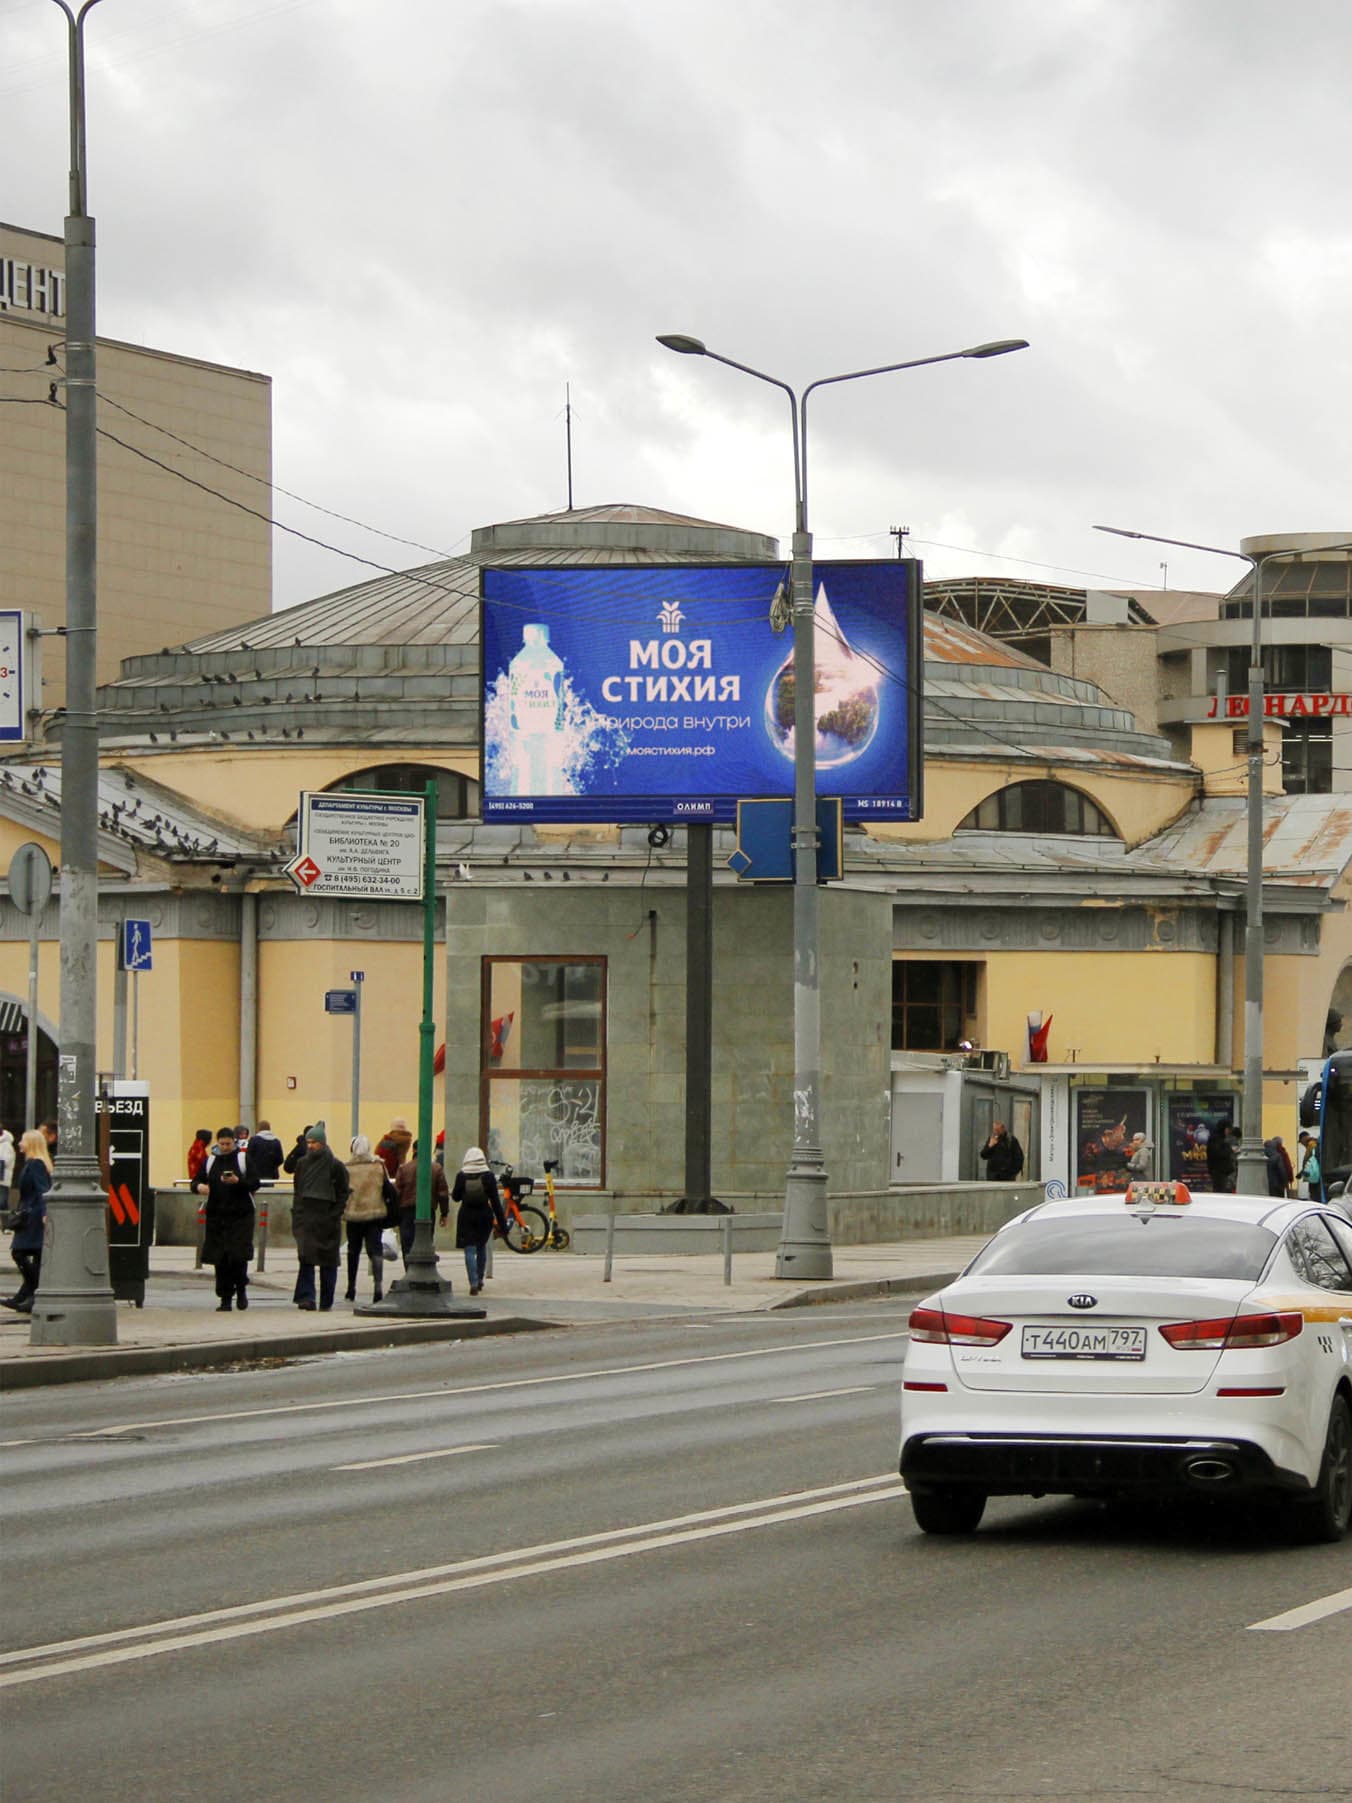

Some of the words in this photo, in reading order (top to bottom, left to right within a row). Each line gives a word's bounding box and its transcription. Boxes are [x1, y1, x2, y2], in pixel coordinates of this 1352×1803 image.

[629, 639, 712, 669] МОЯ
[0, 667, 8, 678] 3
[601, 675, 741, 702] СТИХИЯ
[683, 716, 751, 731] внутри
[627, 745, 716, 757] моястихия.рф
[330, 837, 378, 846] БИБЛИОТЕКА
[327, 856, 376, 864] КУЛЬТУРНЫЙ
[378, 858, 401, 866] ЦЕНТР
[341, 875, 360, 884] (495)
[314, 884, 368, 892] ГОСПИТАЛЬНЫЙ
[1072, 1296, 1093, 1306] KIA
[1031, 1331, 1106, 1350] Т440АМ
[1111, 1330, 1140, 1345] 797
